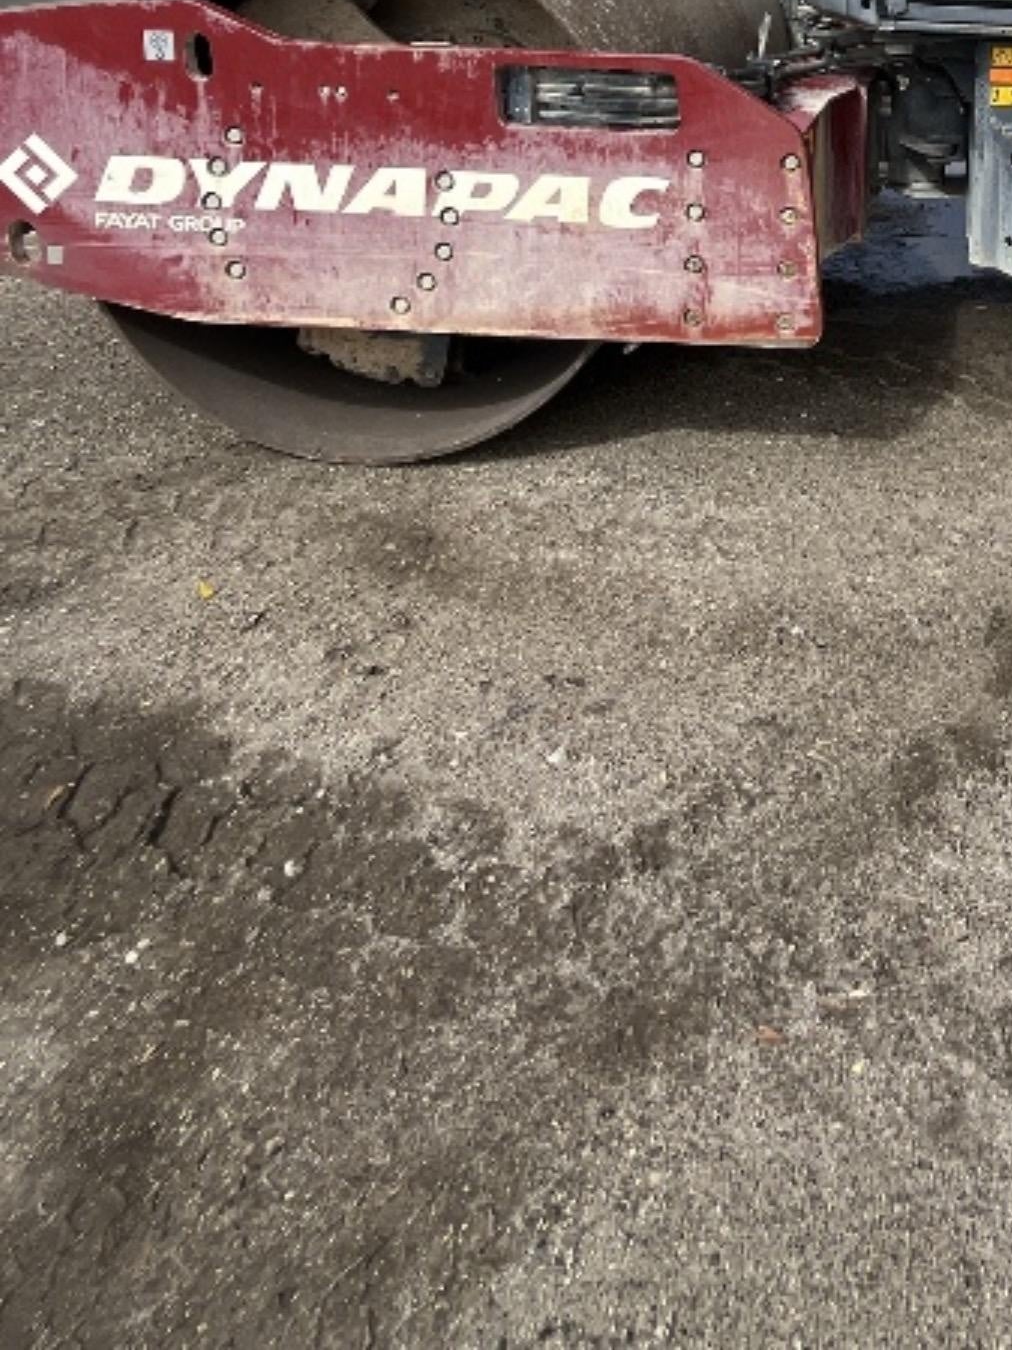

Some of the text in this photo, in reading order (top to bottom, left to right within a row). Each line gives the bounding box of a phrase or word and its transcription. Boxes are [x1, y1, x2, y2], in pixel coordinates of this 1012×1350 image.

[94, 154, 672, 230] DYNAPAC
[94, 211, 247, 234] FAYAT GROUP
